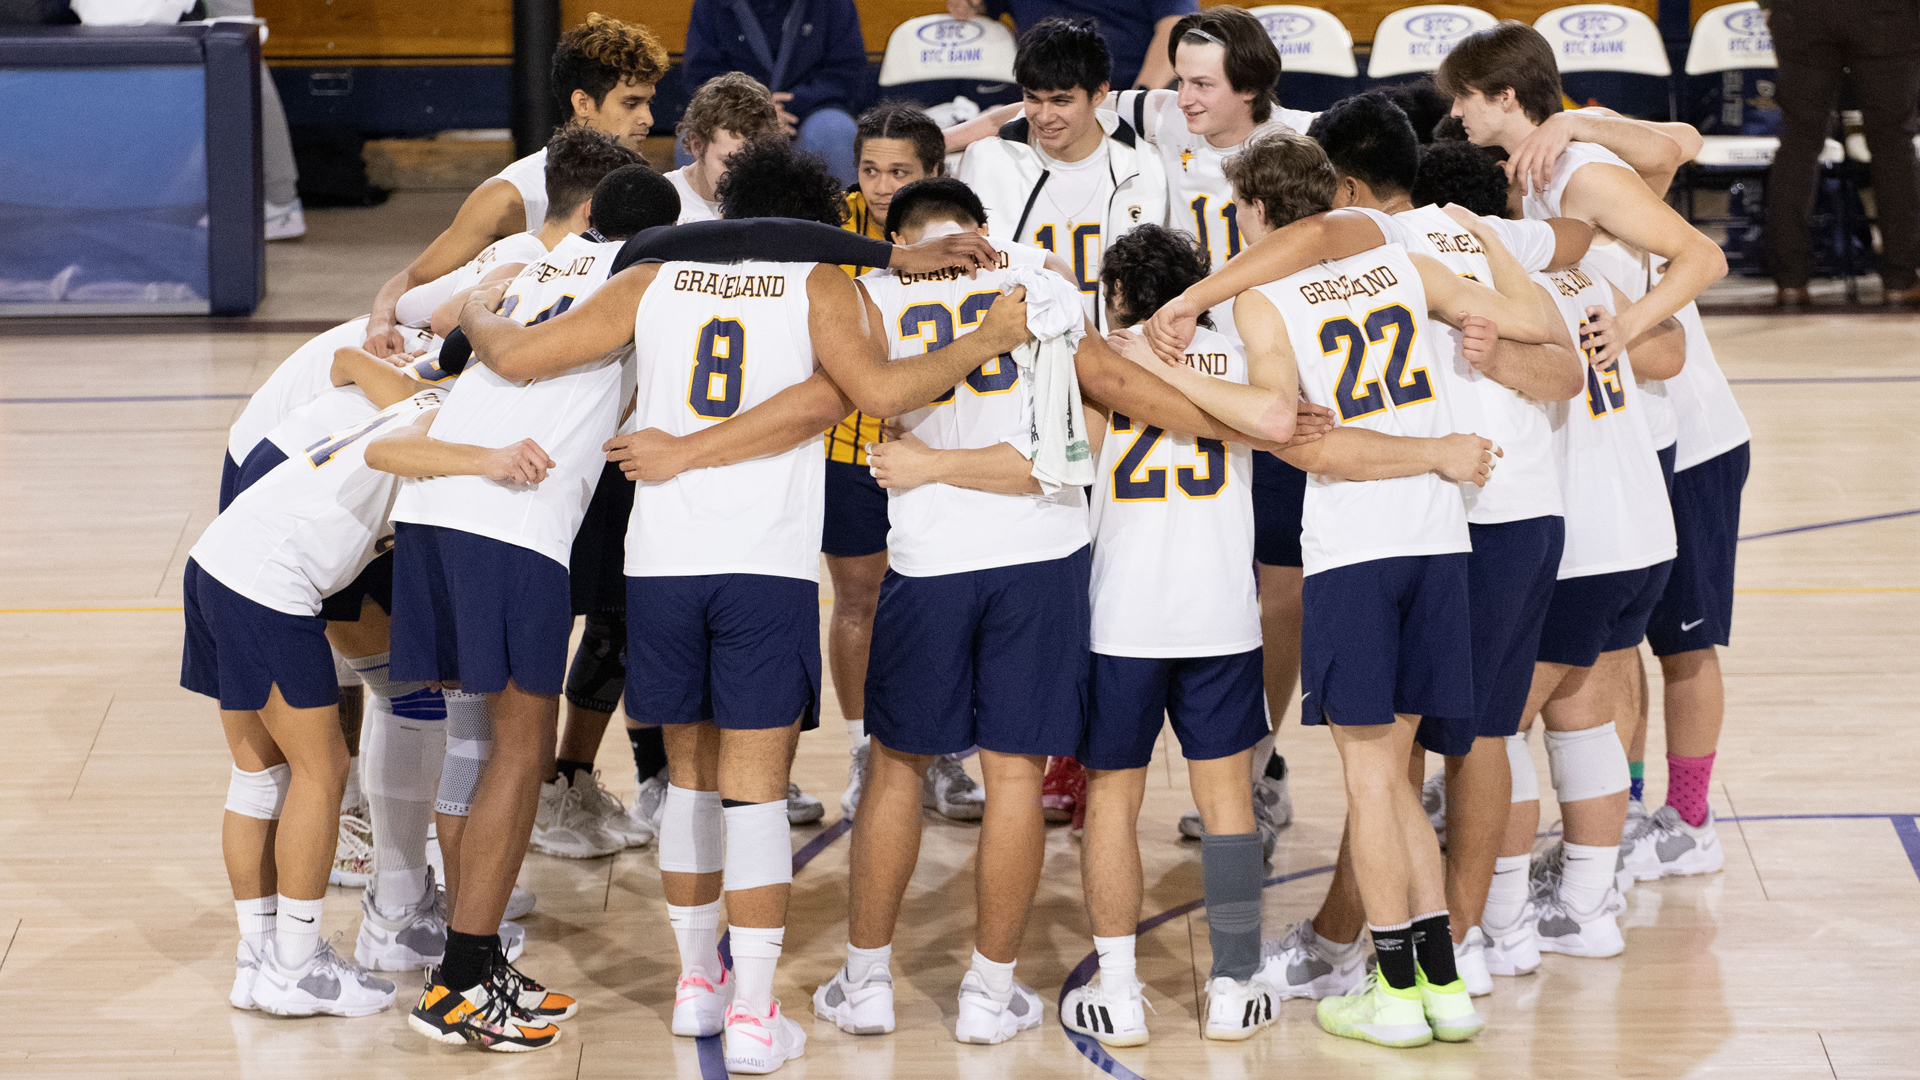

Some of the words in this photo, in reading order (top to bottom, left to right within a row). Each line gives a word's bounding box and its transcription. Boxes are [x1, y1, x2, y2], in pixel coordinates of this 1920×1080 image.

[1265, 17, 1296, 32] BTC
[1423, 17, 1454, 32] BTC
[1576, 16, 1608, 31] BTC
[935, 24, 965, 40] BTC
[1409, 41, 1431, 55] BTC
[1436, 42, 1457, 55] BA
[1563, 40, 1585, 53] BTC
[1590, 40, 1624, 53] BANK
[1729, 38, 1751, 50] BTC
[1756, 38, 1774, 50] BA
[921, 49, 943, 62] BTC
[948, 48, 981, 61] BANK
[1190, 193, 1244, 266] 11
[674, 270, 785, 299] GRACELAND
[686, 315, 746, 421] 8
[1316, 301, 1436, 424] 22
[1110, 411, 1229, 502] 23
